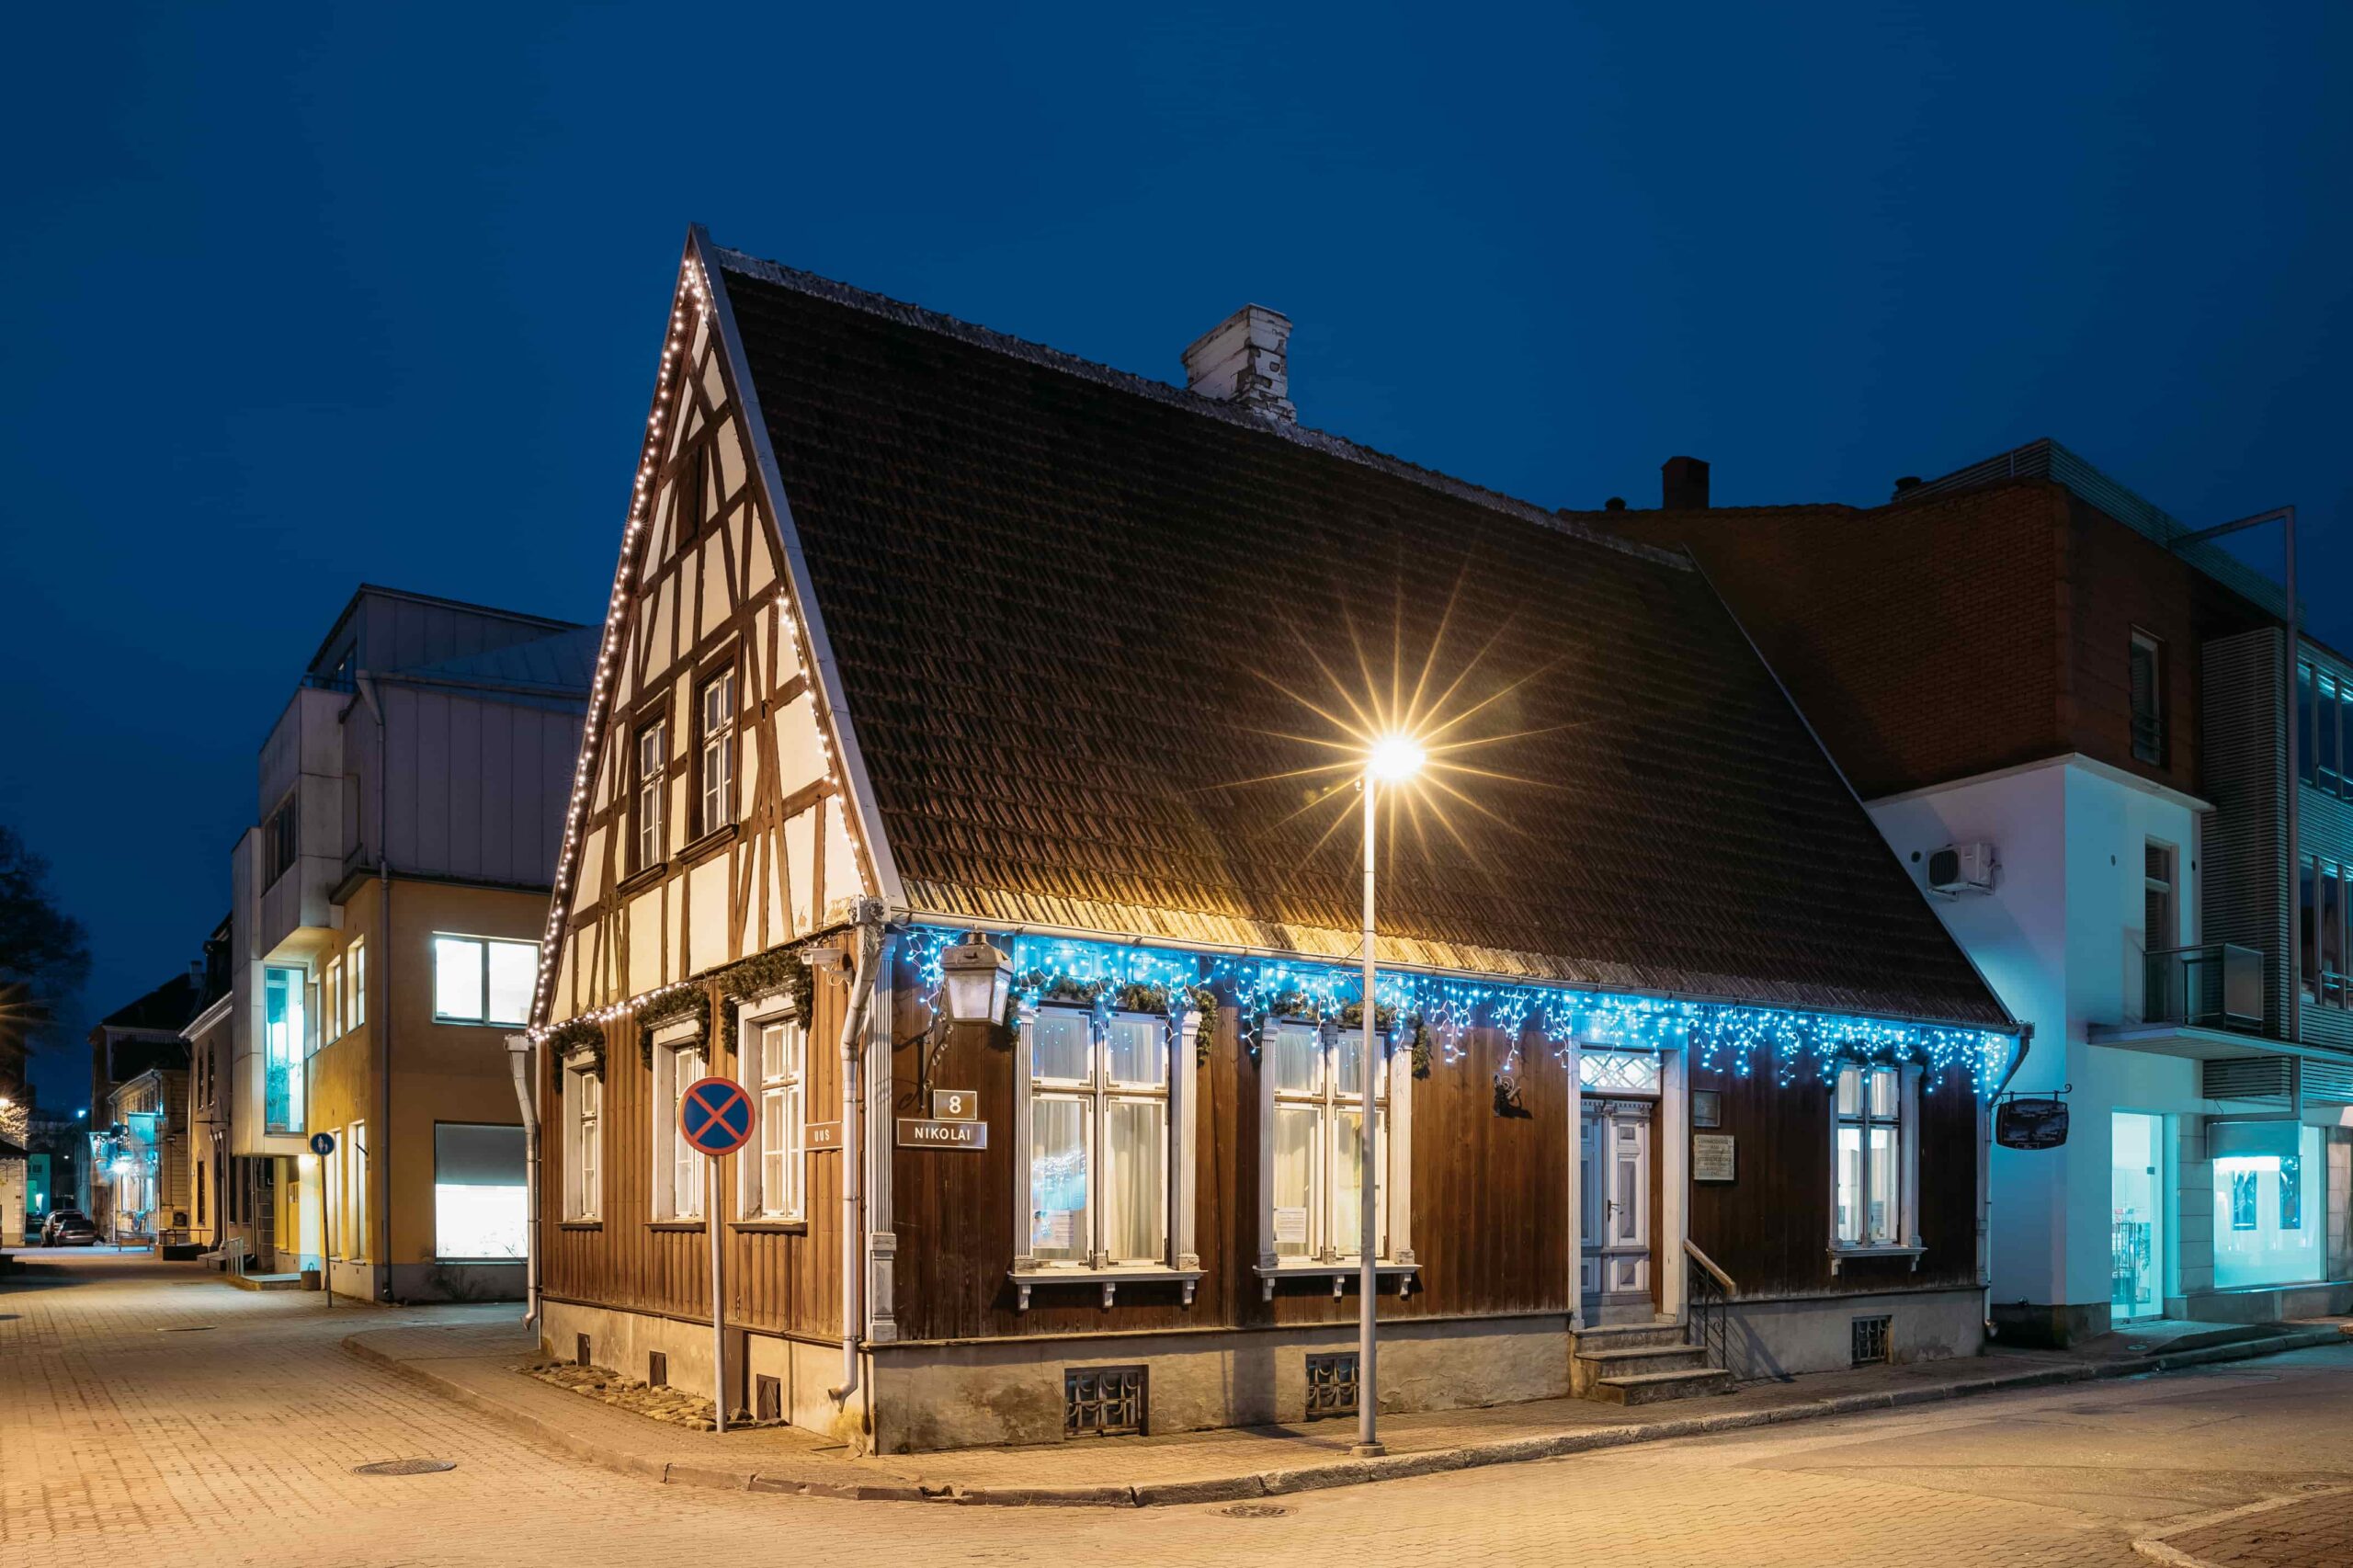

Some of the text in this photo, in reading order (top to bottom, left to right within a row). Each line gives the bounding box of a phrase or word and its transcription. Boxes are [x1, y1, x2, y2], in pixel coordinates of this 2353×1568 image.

[949, 1095, 961, 1114] 8
[813, 1129, 830, 1142] UUS
[915, 1127, 971, 1141] NIKOLAI
